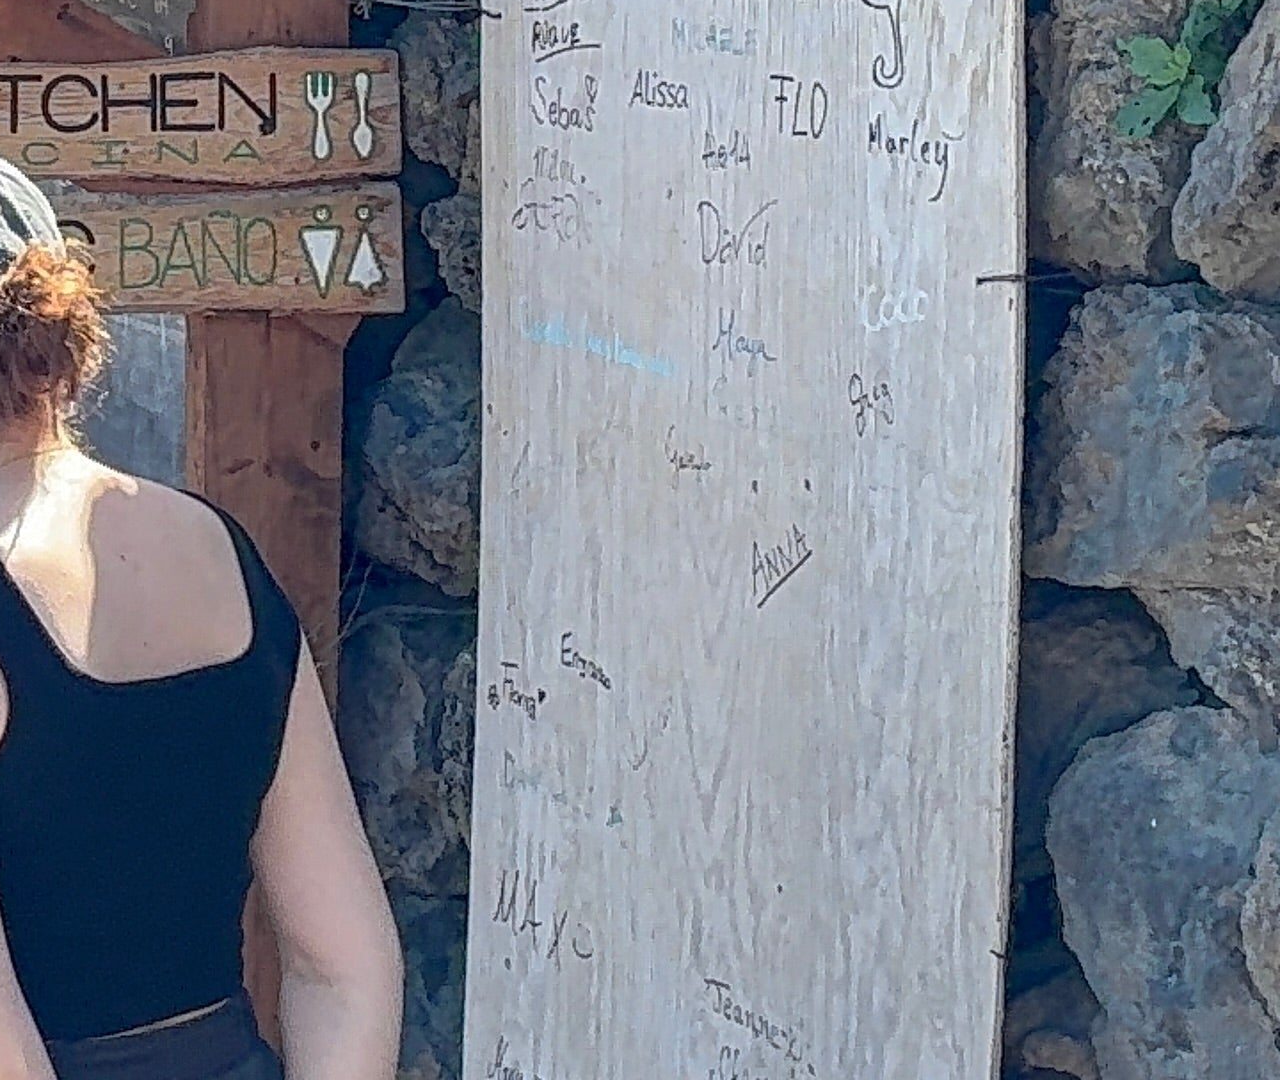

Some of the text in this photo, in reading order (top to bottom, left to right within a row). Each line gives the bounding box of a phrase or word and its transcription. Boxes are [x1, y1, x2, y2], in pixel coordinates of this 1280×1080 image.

[628, 69, 689, 110] Alissa
[770, 74, 828, 138] FLO
[21, 139, 265, 166] CINA
[867, 113, 965, 202] Marley
[119, 209, 278, 290] BAÑO
[752, 522, 808, 597] ANNA
